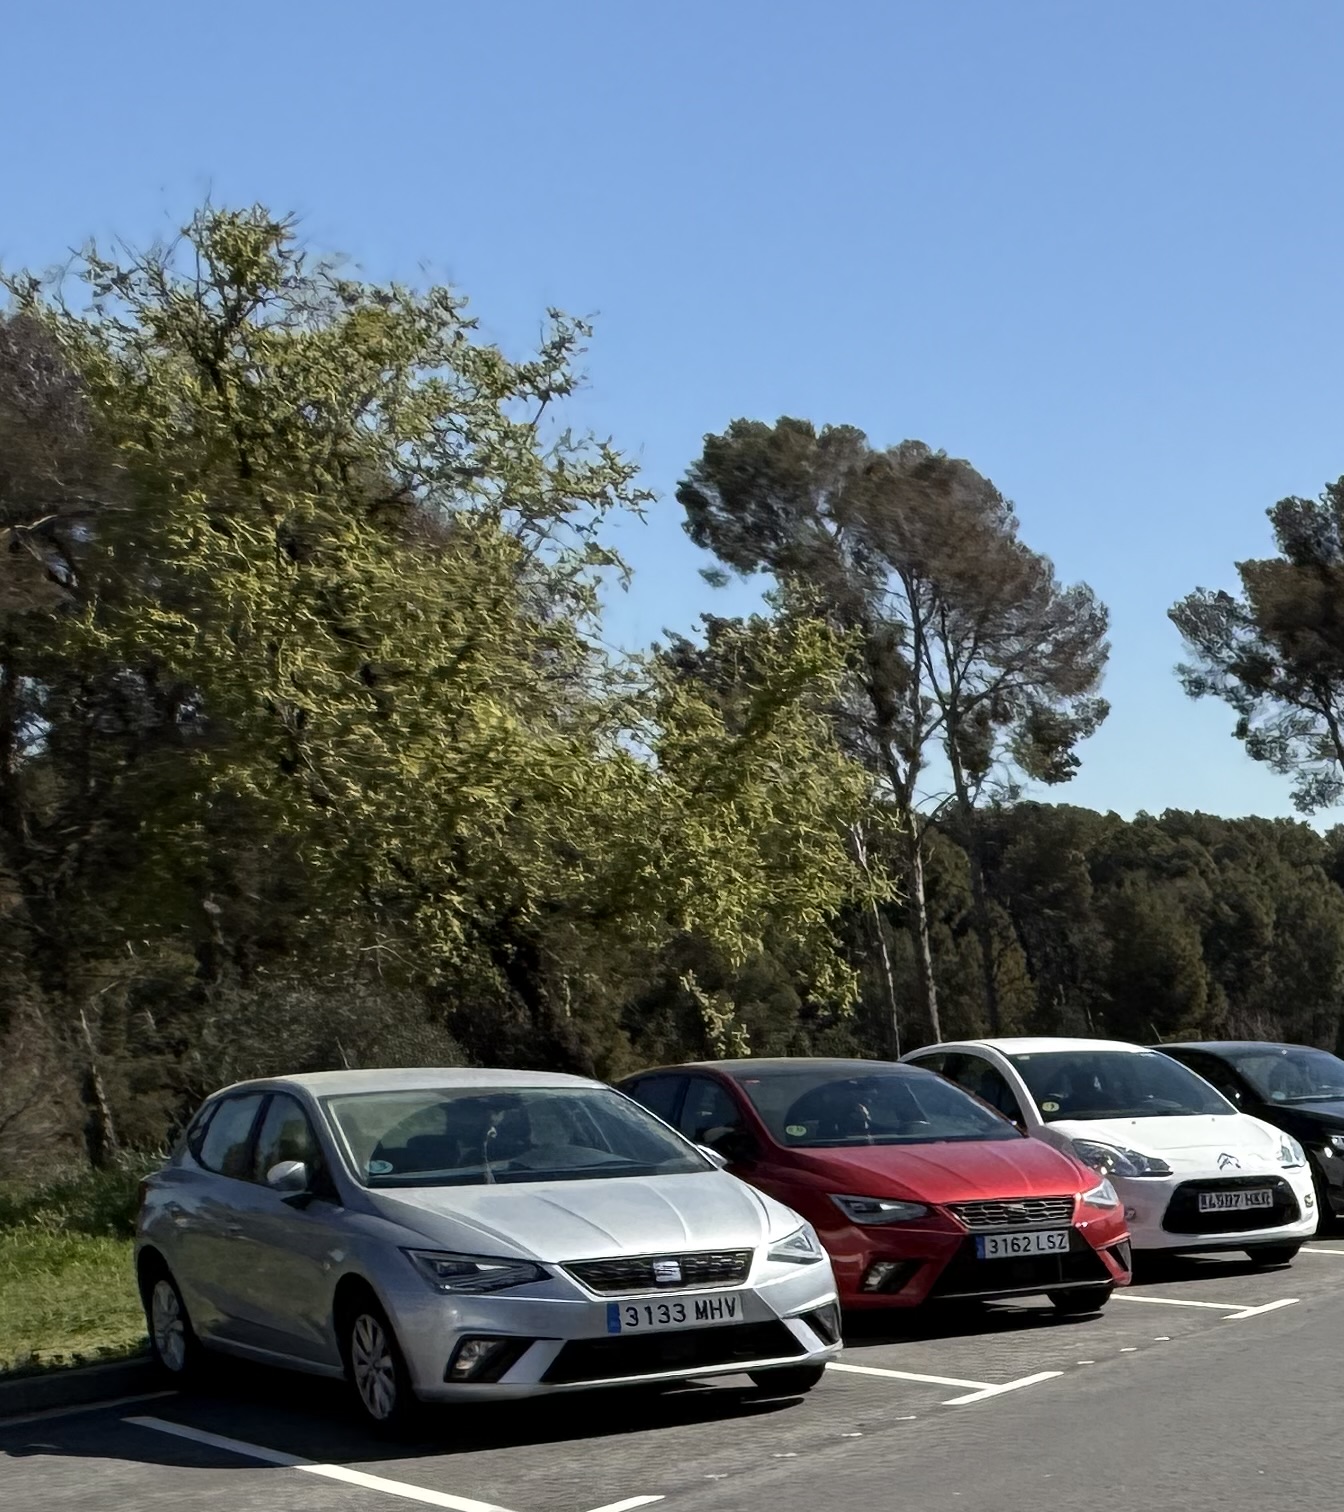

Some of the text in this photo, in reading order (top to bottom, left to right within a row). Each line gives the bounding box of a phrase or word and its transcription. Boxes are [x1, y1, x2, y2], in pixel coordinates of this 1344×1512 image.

[989, 1233, 1067, 1254] 3162 LSZ
[624, 1297, 736, 1327] 3133 MHV
